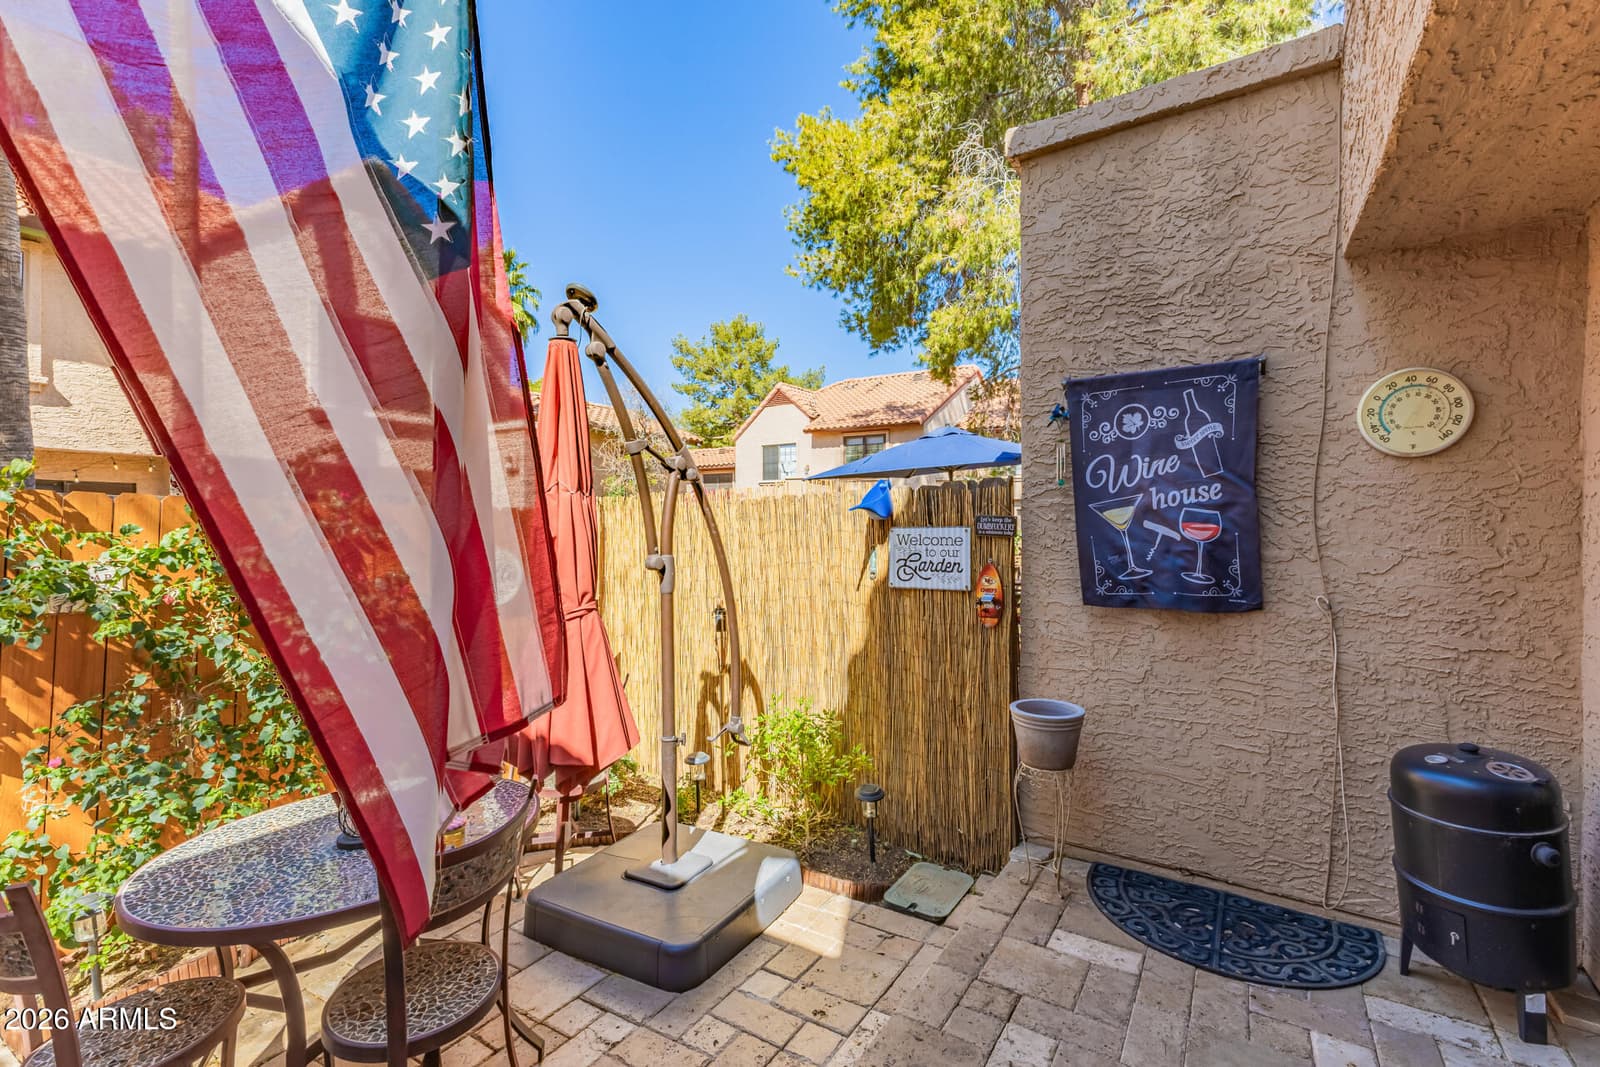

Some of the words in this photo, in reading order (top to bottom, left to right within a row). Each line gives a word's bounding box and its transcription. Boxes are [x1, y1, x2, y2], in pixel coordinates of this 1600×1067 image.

[1385, 381, 1398, 390] 20
[1443, 383, 1455, 393] 80
[1454, 396, 1464, 408] 100
[1452, 414, 1464, 426] 120
[1438, 430, 1454, 441] 140
[1086, 454, 1180, 494] Wine
[1151, 483, 1222, 510] house
[896, 534, 964, 546] Welcome
[926, 547, 936, 558] to
[940, 549, 960, 558] our
[896, 553, 963, 582] Garden
